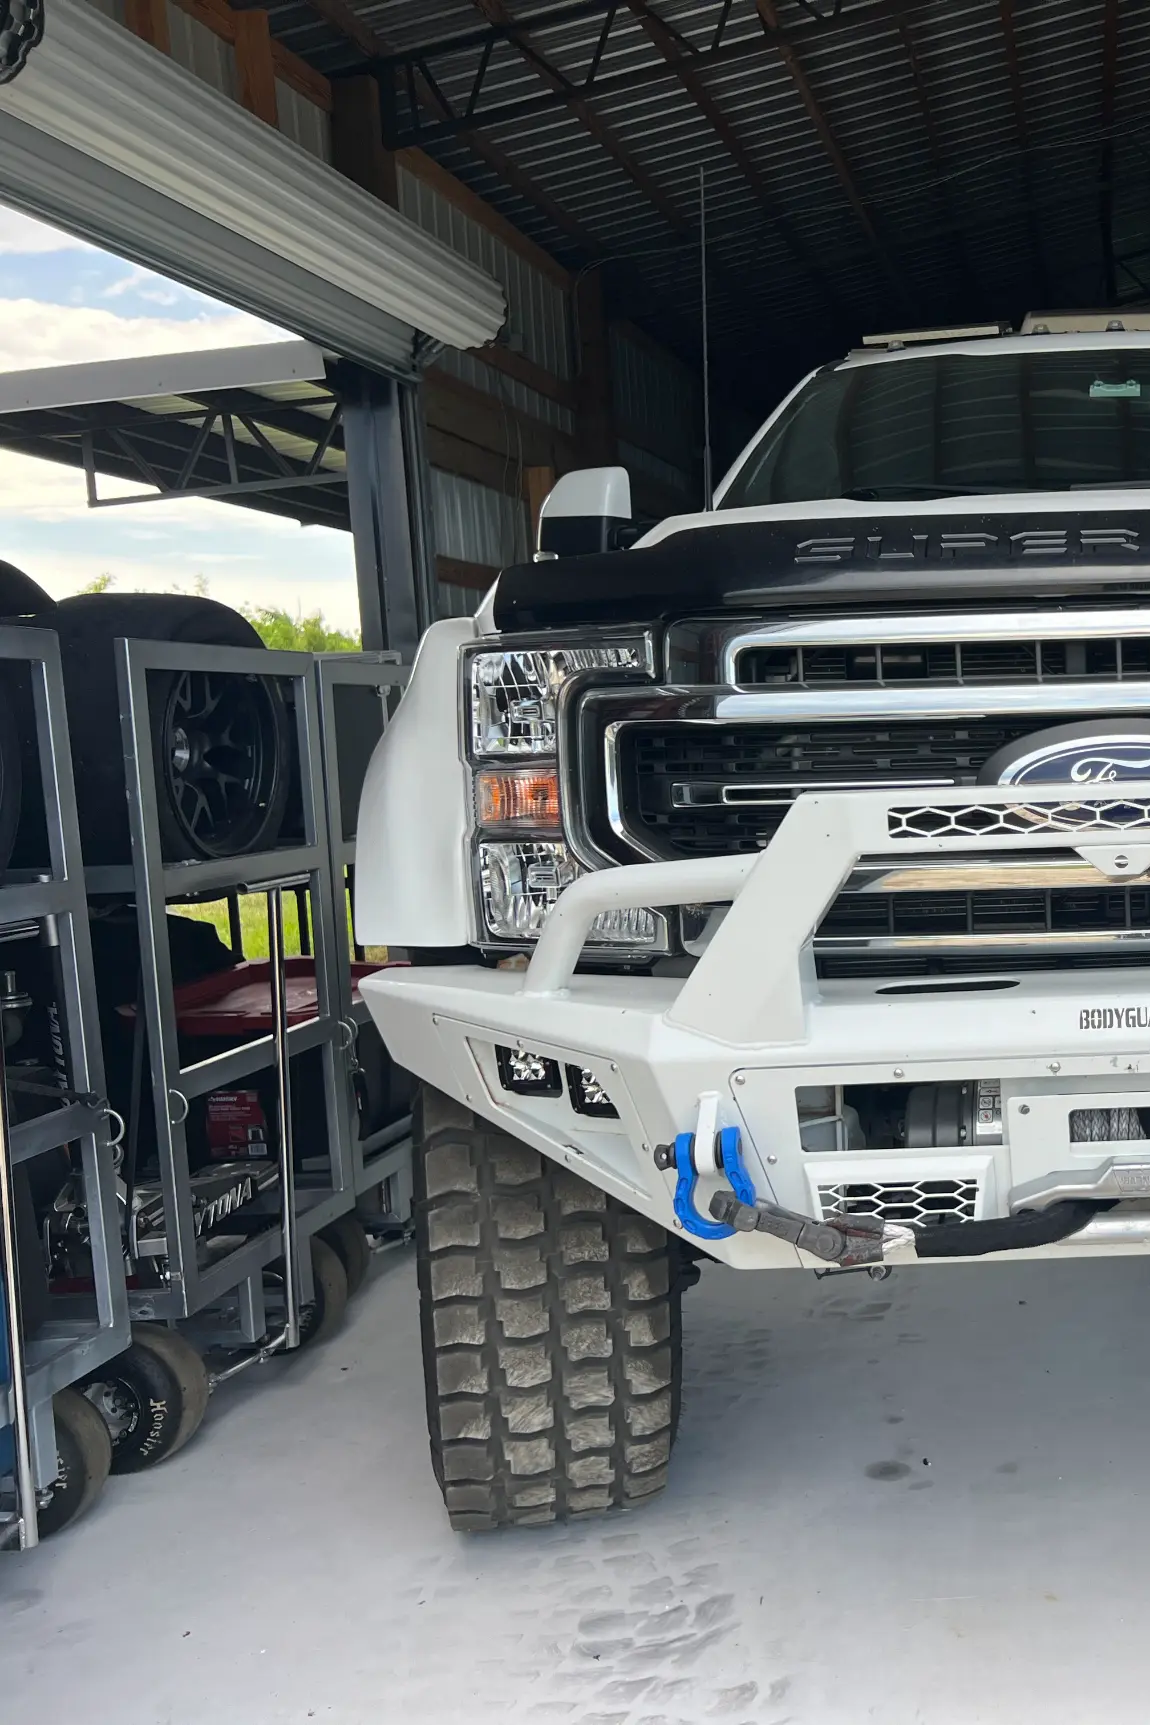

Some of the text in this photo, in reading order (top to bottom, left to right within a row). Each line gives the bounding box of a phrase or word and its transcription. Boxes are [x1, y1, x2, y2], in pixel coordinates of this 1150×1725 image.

[794, 528, 1139, 564] SUPER
[193, 1176, 252, 1238] YTONA
[139, 1398, 168, 1456] Hoosier
